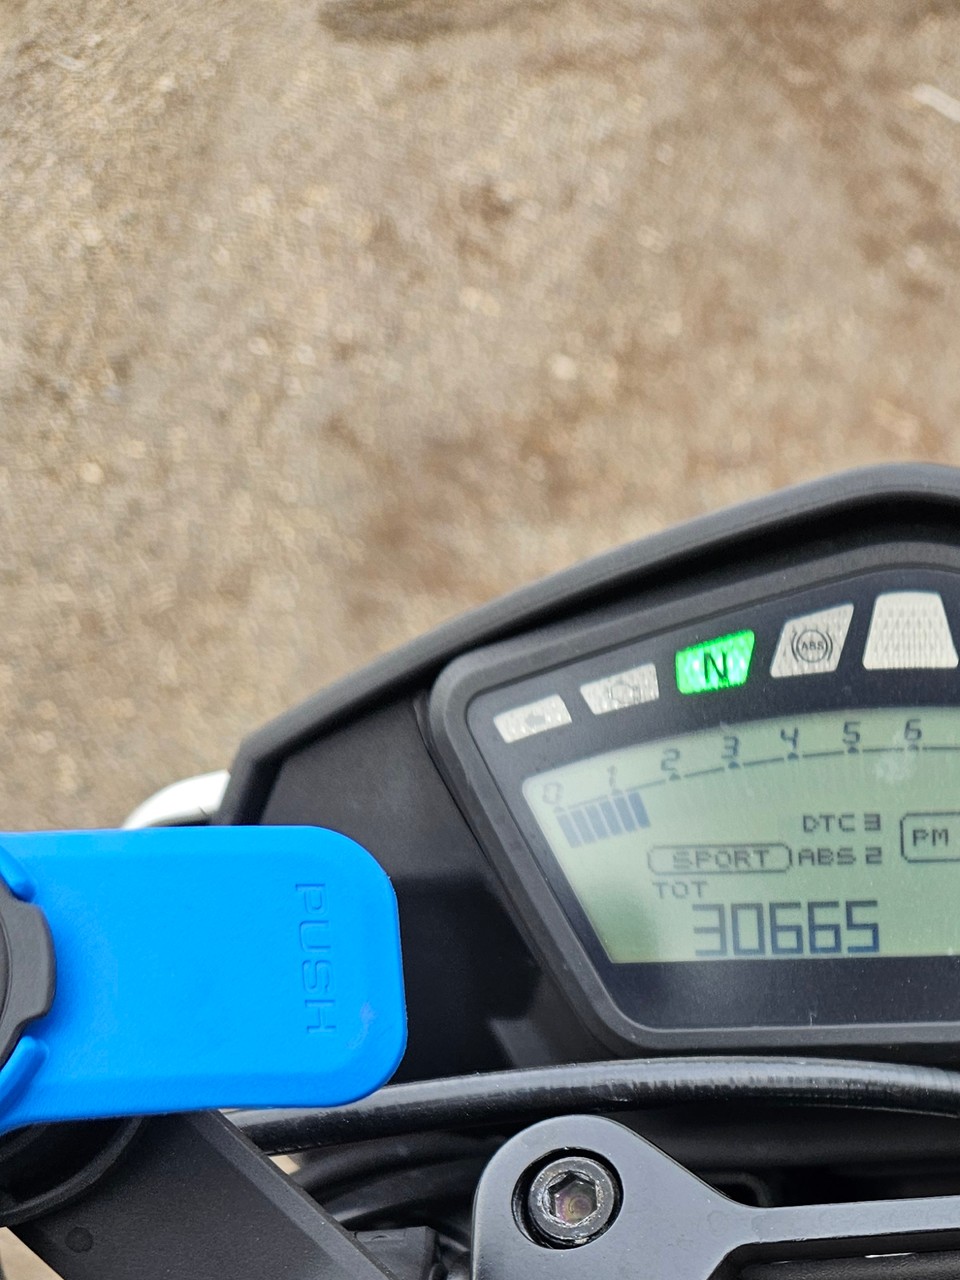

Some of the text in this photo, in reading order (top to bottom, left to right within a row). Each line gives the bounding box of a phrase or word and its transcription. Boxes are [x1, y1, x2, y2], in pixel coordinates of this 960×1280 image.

[801, 640, 824, 651] ABS
[703, 652, 729, 682] N
[660, 748, 681, 772] 2
[720, 735, 740, 760] 3
[779, 727, 800, 752] 4
[842, 720, 861, 745] 5
[903, 718, 922, 743] 6
[802, 813, 881, 833] DTC 3
[912, 828, 949, 847] PM
[672, 849, 770, 870] SPORT
[798, 846, 883, 866] ABS 2
[651, 880, 708, 899] TOT
[692, 900, 880, 956] 30665
[295, 883, 337, 1035] PUSH
